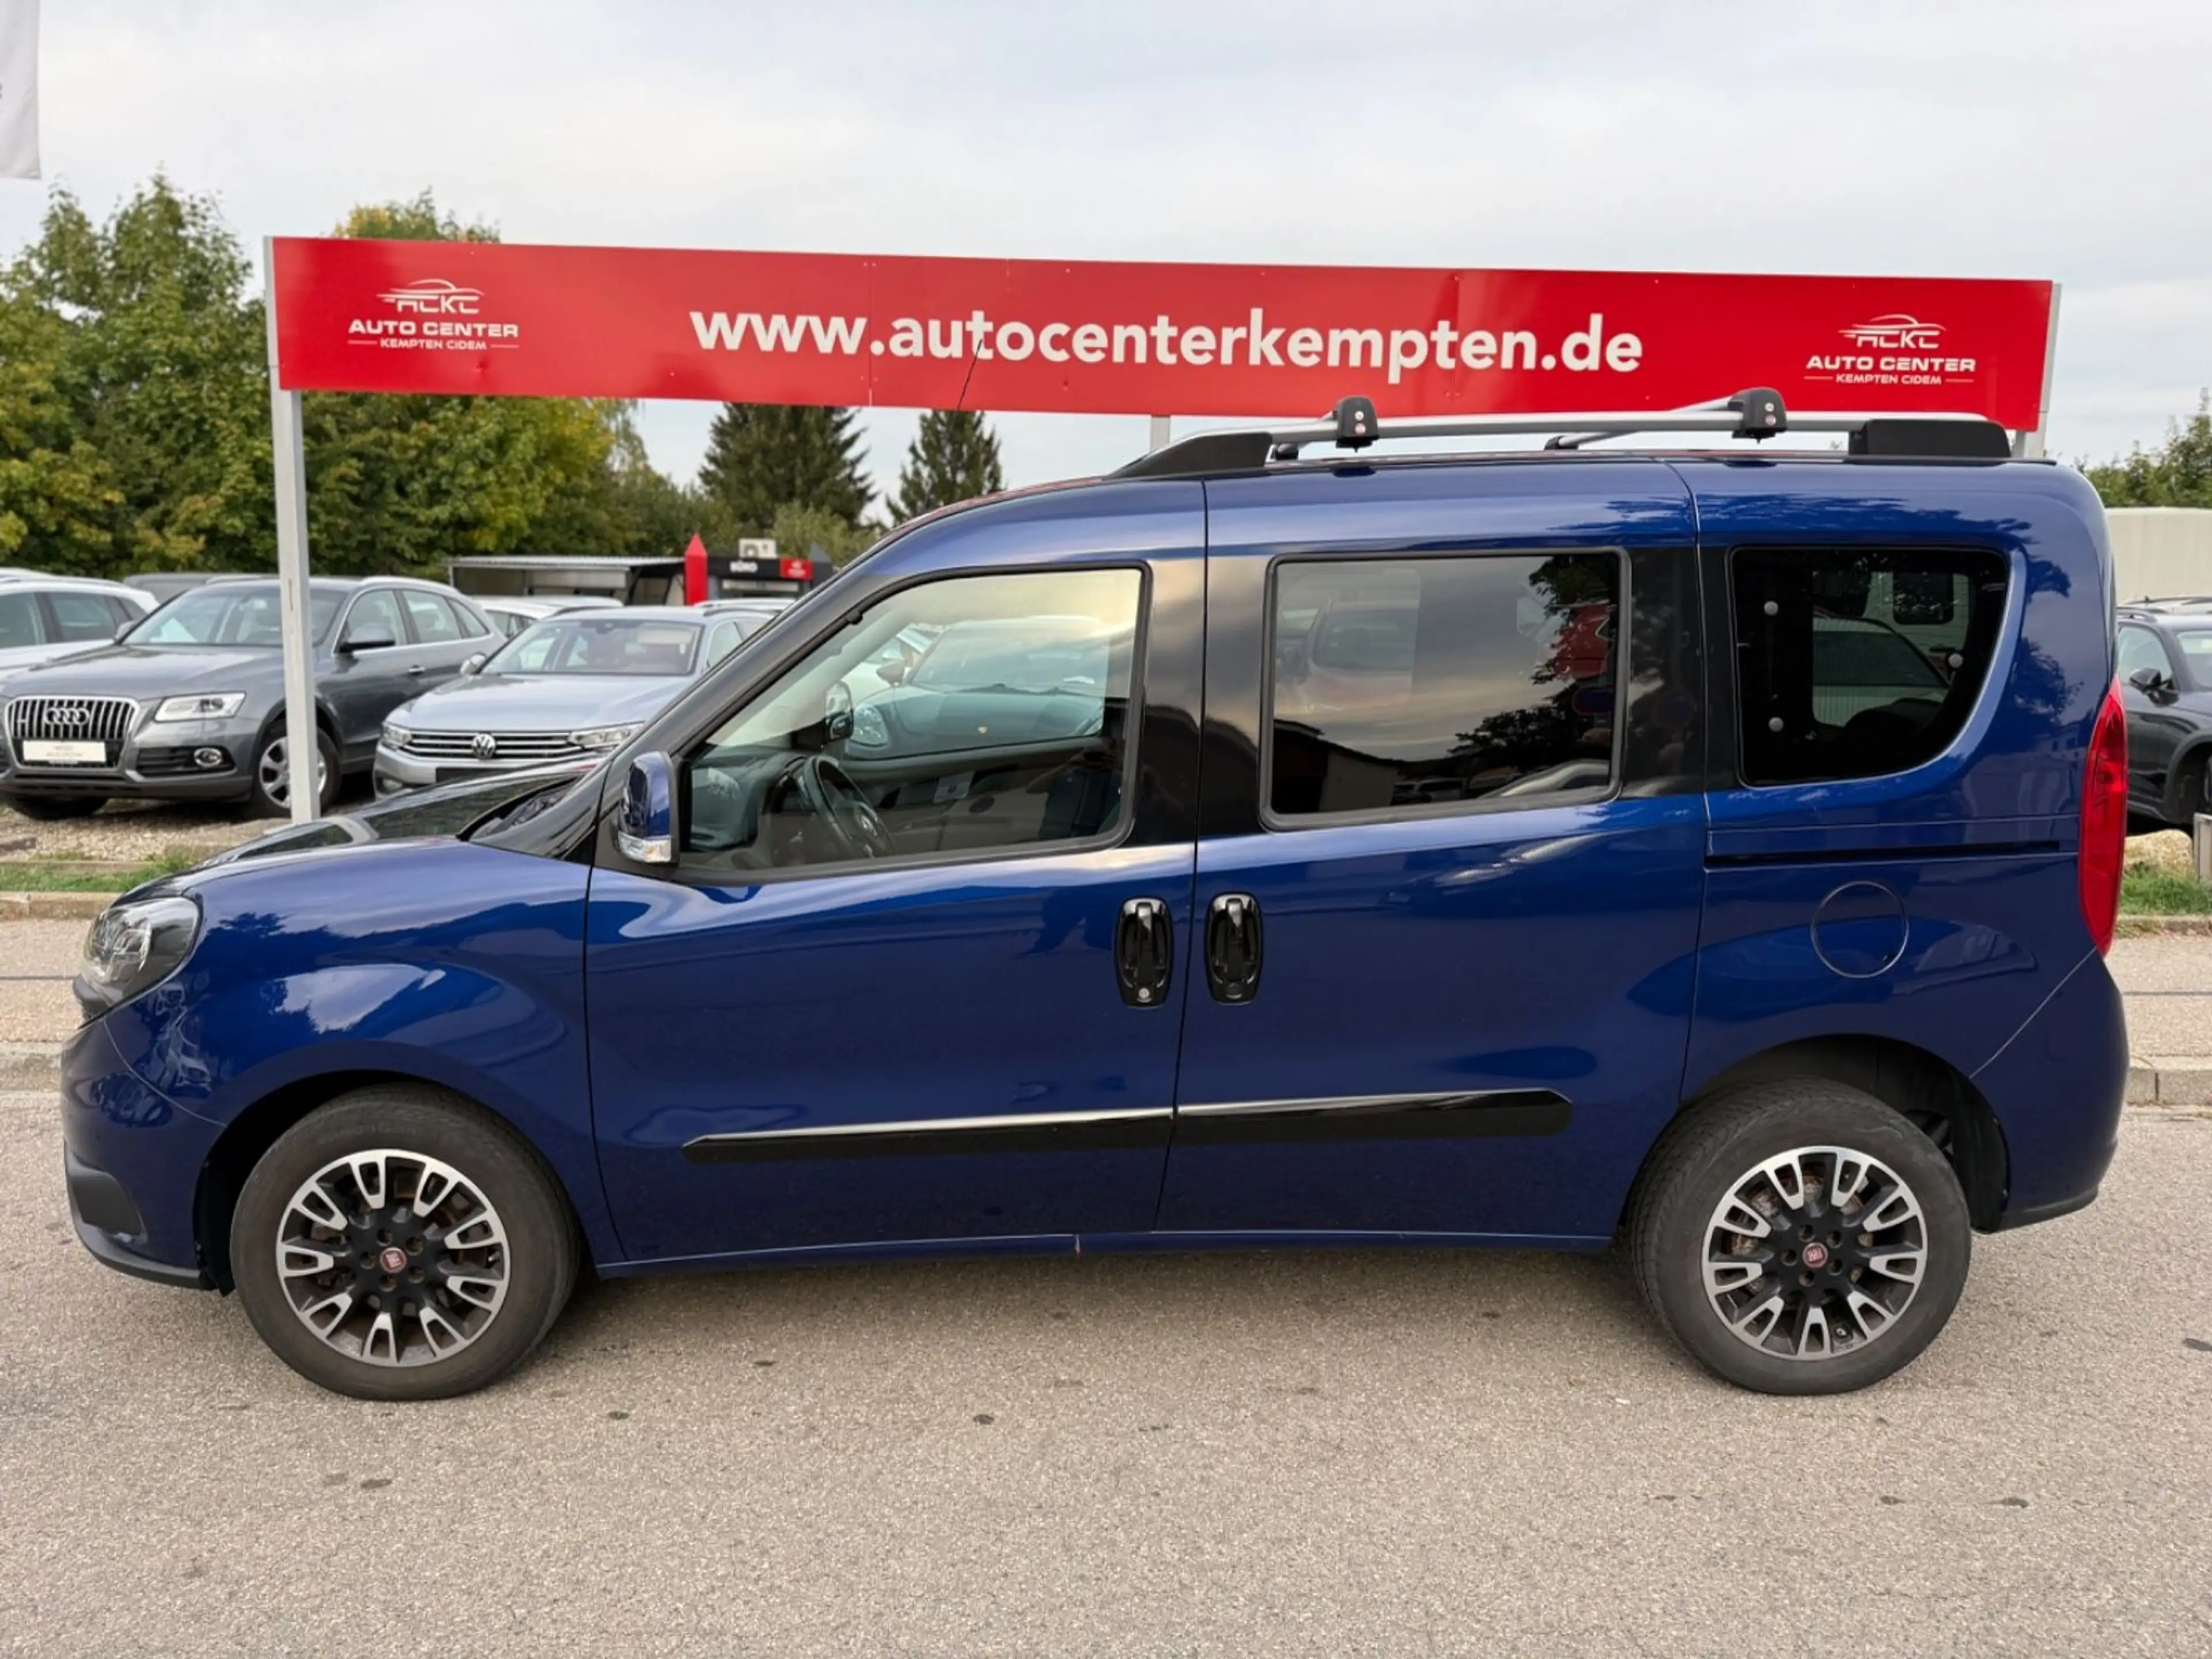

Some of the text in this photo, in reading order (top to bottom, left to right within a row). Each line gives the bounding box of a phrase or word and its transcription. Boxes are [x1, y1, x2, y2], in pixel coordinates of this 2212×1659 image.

[349, 320, 519, 338] AUTO CENTER
[381, 338, 487, 351] KEMPTEN CIDEM
[690, 308, 1642, 384] www.autocenterkempten.de
[1806, 355, 1976, 373] AUTO CENTER
[1836, 373, 1941, 385] KEMPTEN CIDEM
